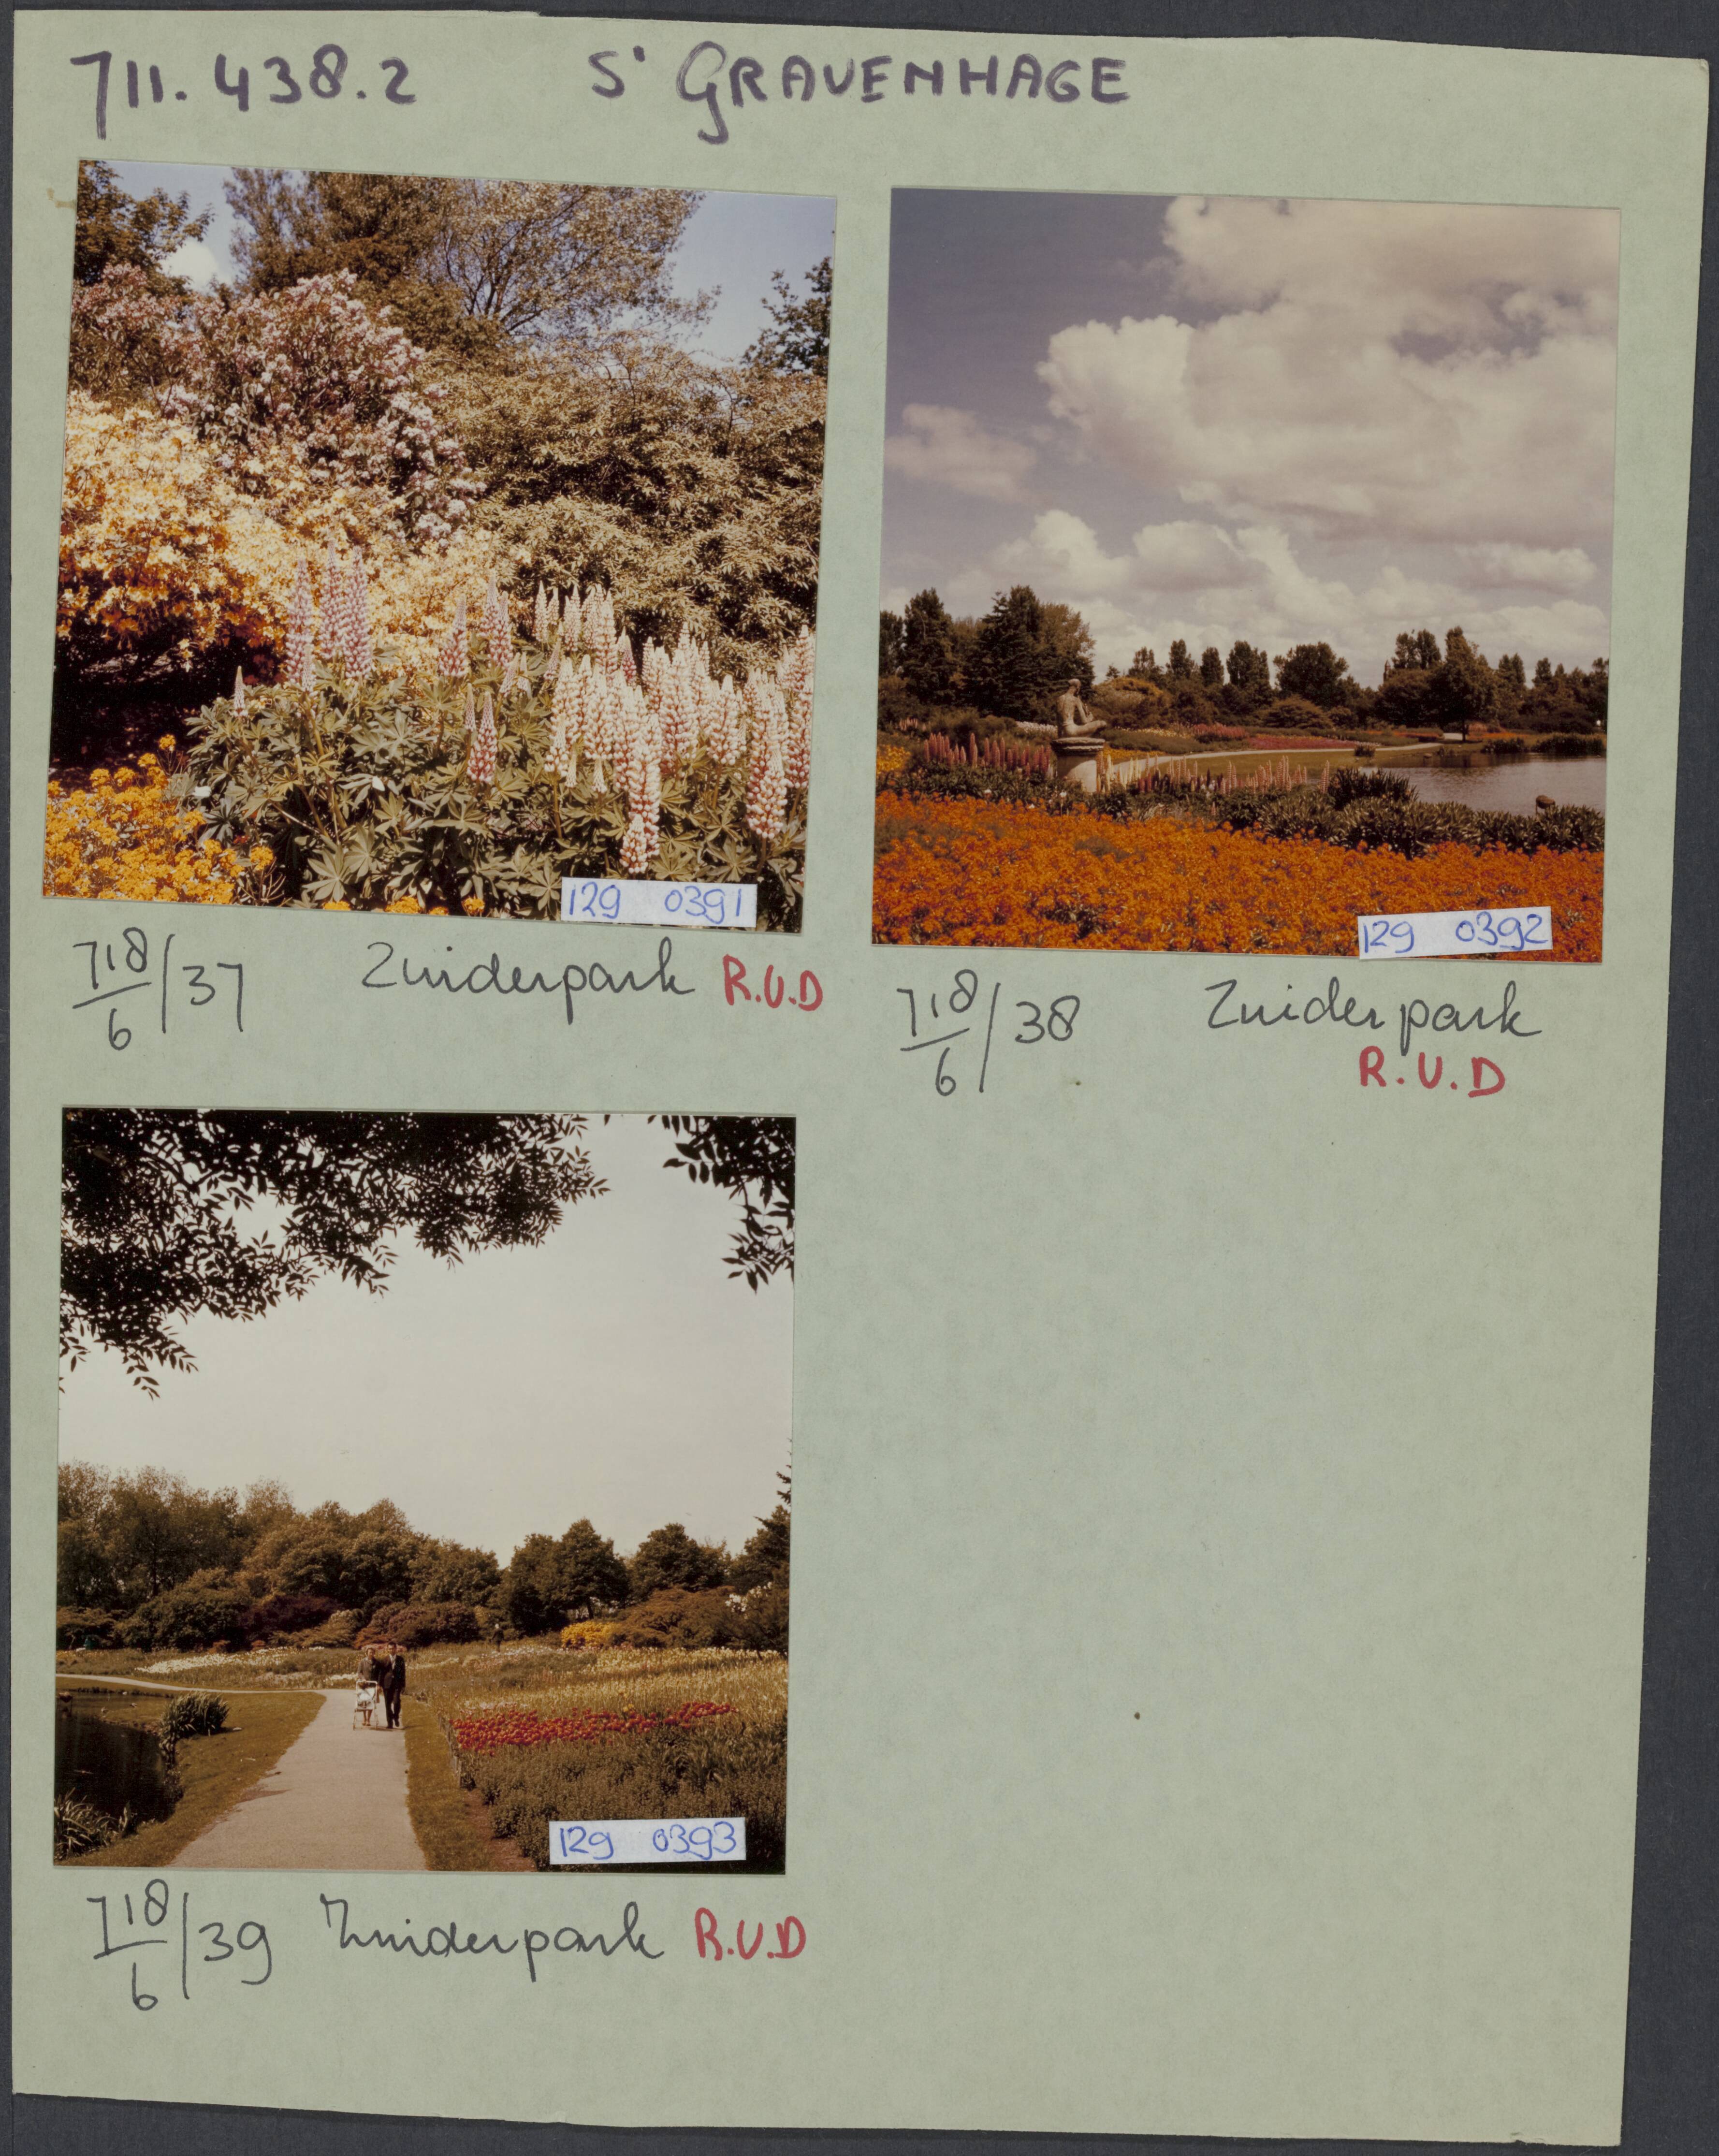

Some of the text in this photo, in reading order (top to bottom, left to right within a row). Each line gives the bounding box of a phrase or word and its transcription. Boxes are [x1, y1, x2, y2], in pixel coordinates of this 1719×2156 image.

[70, 44, 416, 141] 711.438.2
[677, 40, 1131, 145] GRAVENHAGE
[569, 882, 743, 925] 129 0391
[1363, 911, 1549, 953] 129 0392
[362, 936, 696, 1025] Zuiderpark
[560, 1820, 738, 1860] 129 0393
[320, 1894, 665, 1983] Zuiderpark
